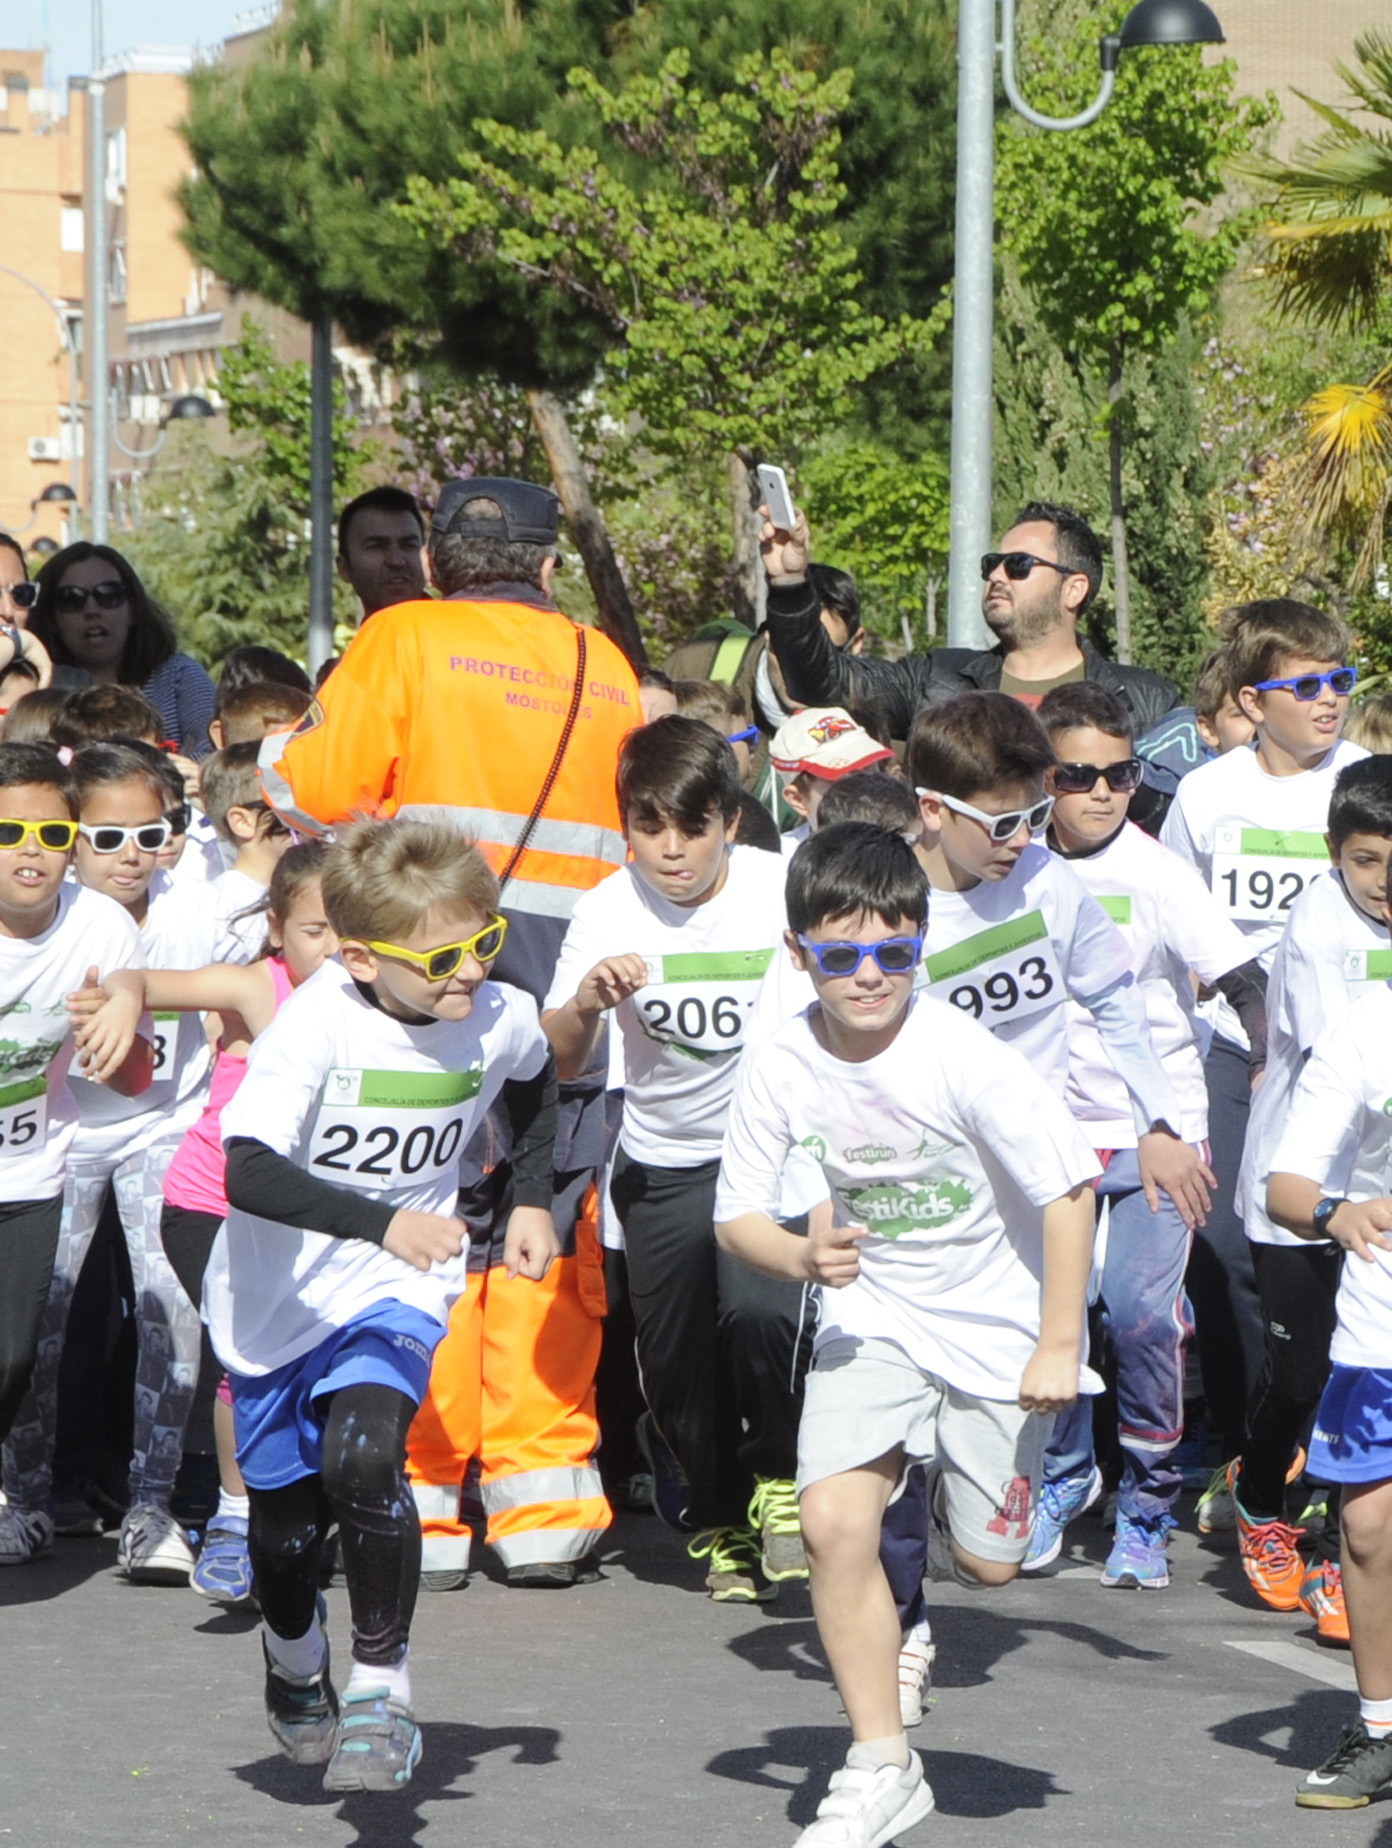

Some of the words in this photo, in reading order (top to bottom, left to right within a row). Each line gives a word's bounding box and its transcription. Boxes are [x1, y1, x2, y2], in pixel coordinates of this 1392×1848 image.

[589, 682, 630, 706] CIVIL
[1221, 868, 1320, 910] 192
[644, 995, 752, 1039] 206
[312, 1118, 463, 1176] 2200
